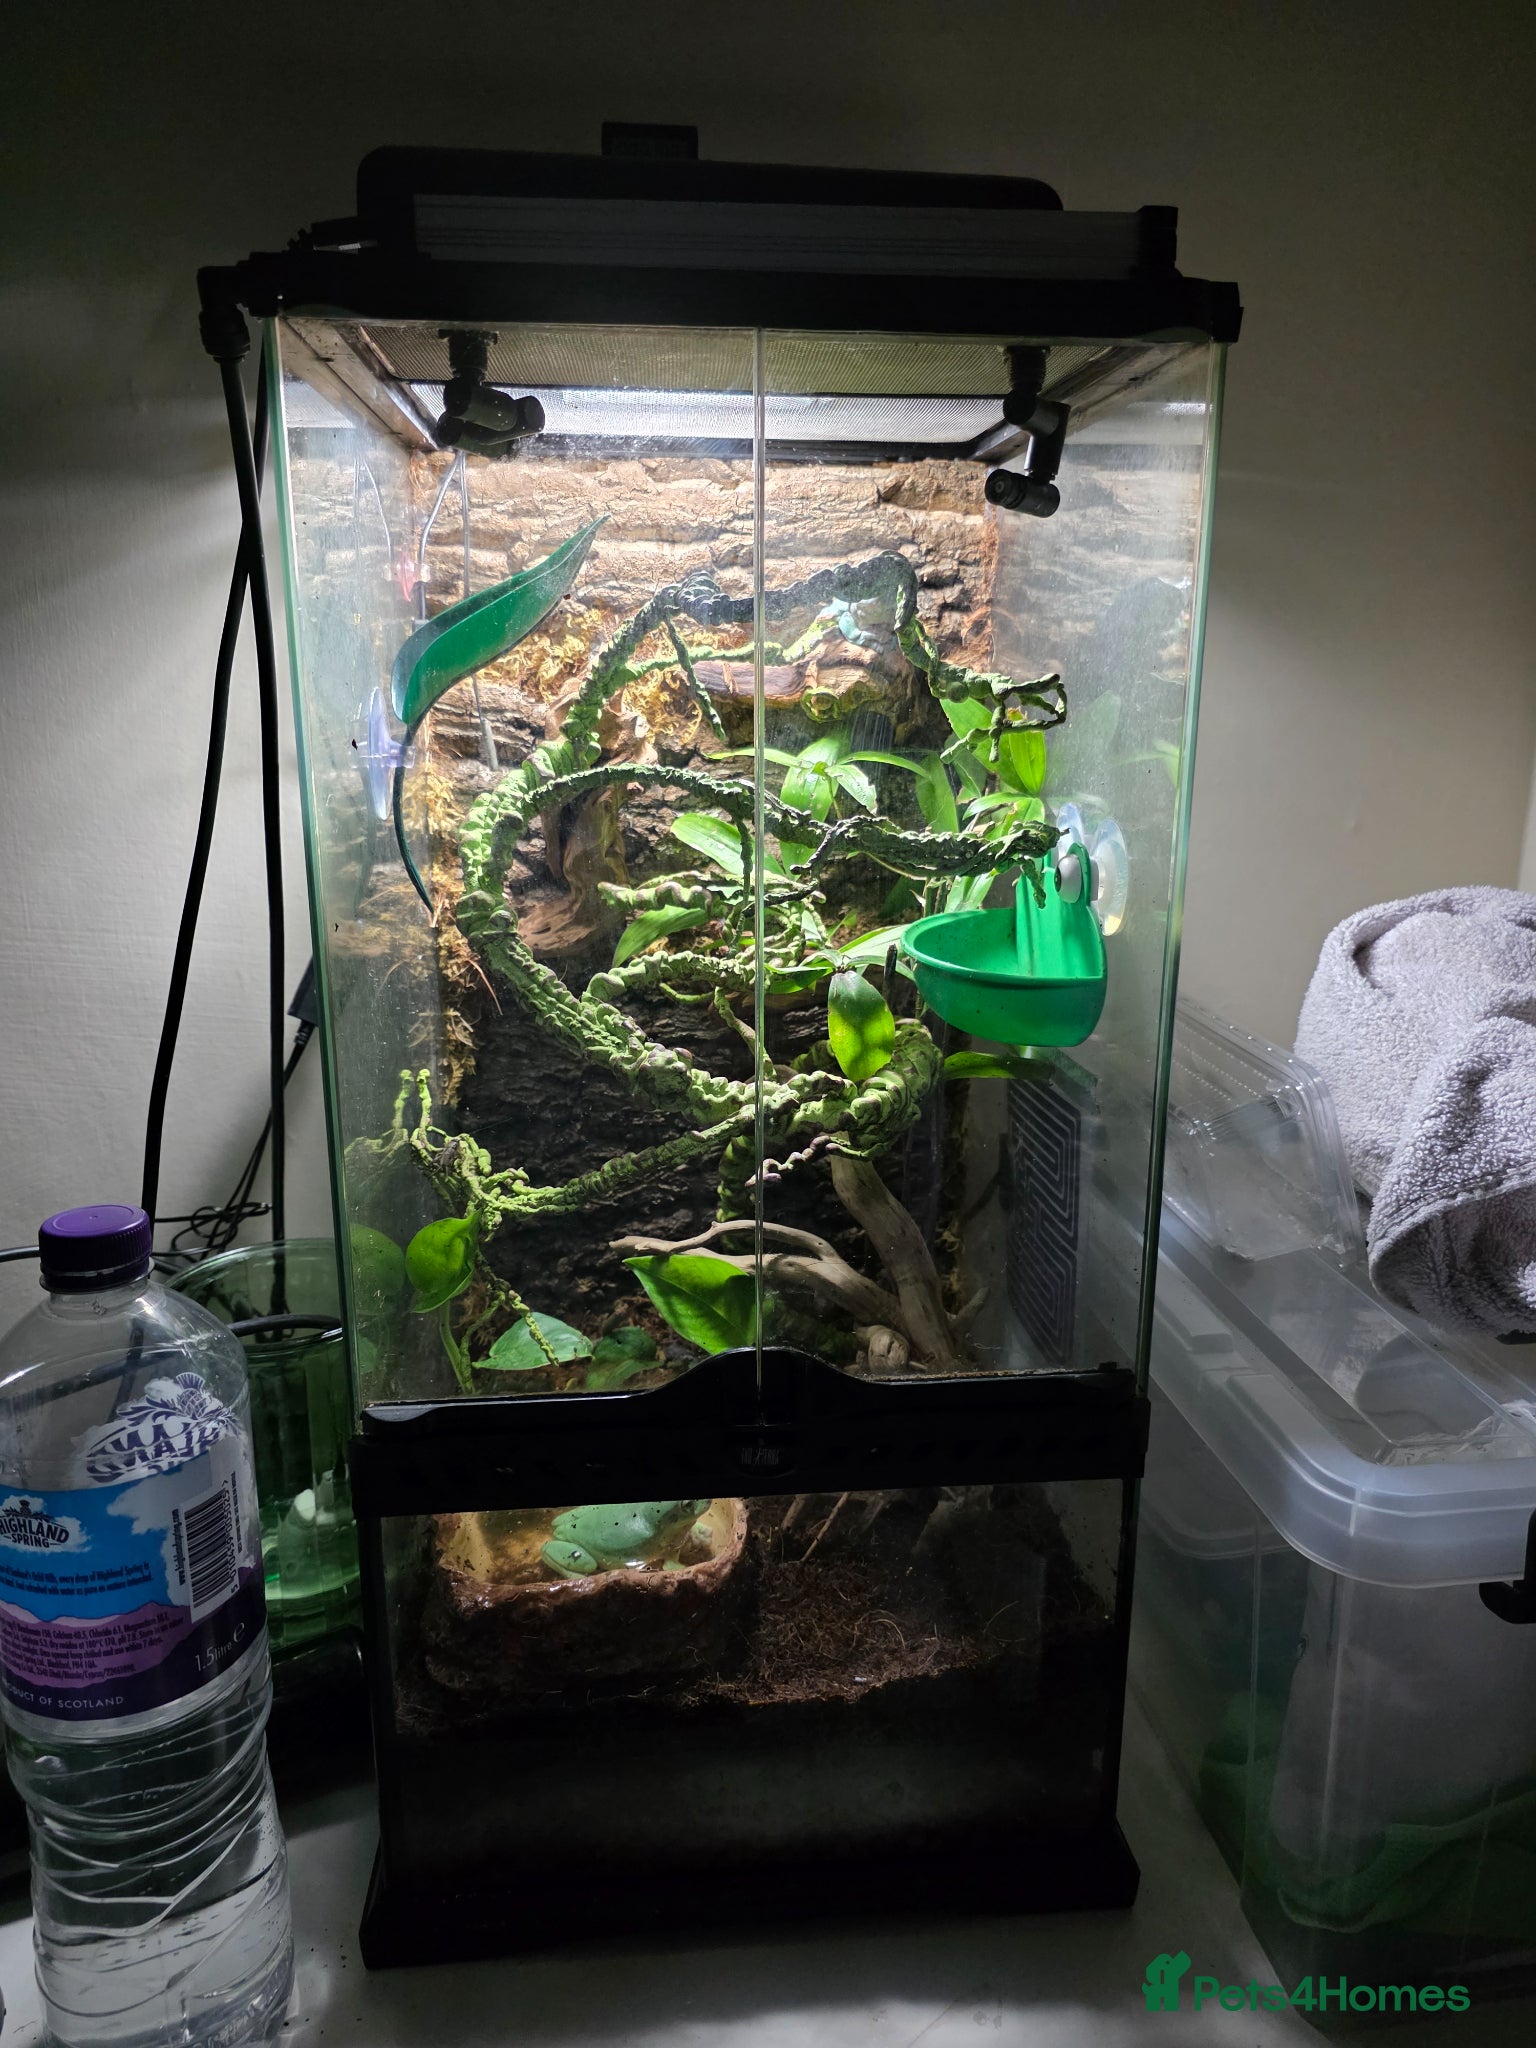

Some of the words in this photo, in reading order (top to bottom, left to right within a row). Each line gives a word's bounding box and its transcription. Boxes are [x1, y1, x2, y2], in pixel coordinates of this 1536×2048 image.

[222, 1490, 233, 1532] 005025
[0, 1518, 69, 1543] HIGHLAND
[12, 1533, 50, 1548] SPRING
[226, 1537, 237, 1578] 010459
[97, 1566, 123, 1581] Highland
[231, 1584, 238, 1593] 5
[39, 1696, 52, 1706] OF
[57, 1696, 124, 1709] SCOTLAND
